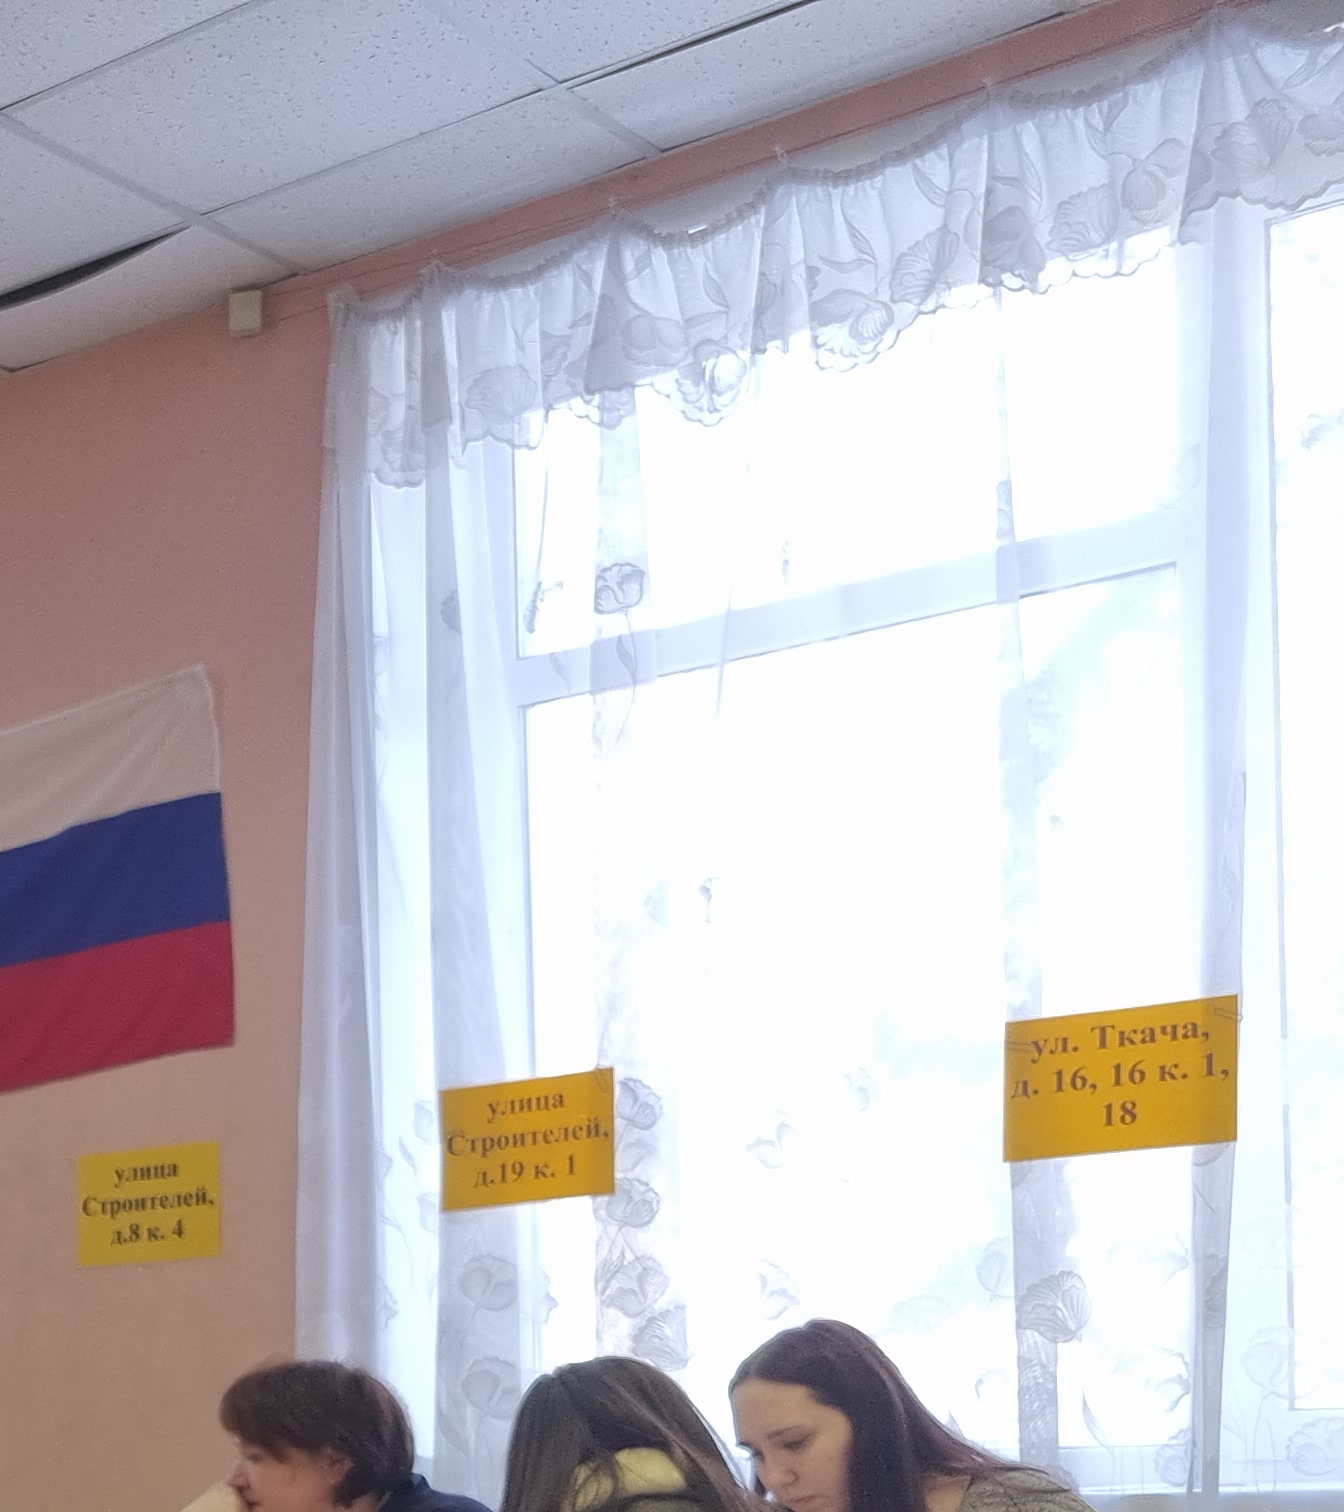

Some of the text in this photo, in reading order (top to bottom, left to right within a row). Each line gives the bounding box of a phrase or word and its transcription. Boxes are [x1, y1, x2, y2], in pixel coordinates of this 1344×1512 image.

[1030, 1021, 1210, 1064] ул. Ткача,
[1011, 1052, 1229, 1100] д. 16, 16 к. 1,
[486, 1092, 565, 1124] улица
[1102, 1101, 1137, 1127] 18
[446, 1118, 609, 1157] Строителей,
[114, 1163, 179, 1189] улица
[473, 1153, 576, 1189] д.19 к. 1
[82, 1185, 215, 1219] Строителей,
[147, 1226, 165, 1242] к.
[171, 1218, 184, 1239] 4
